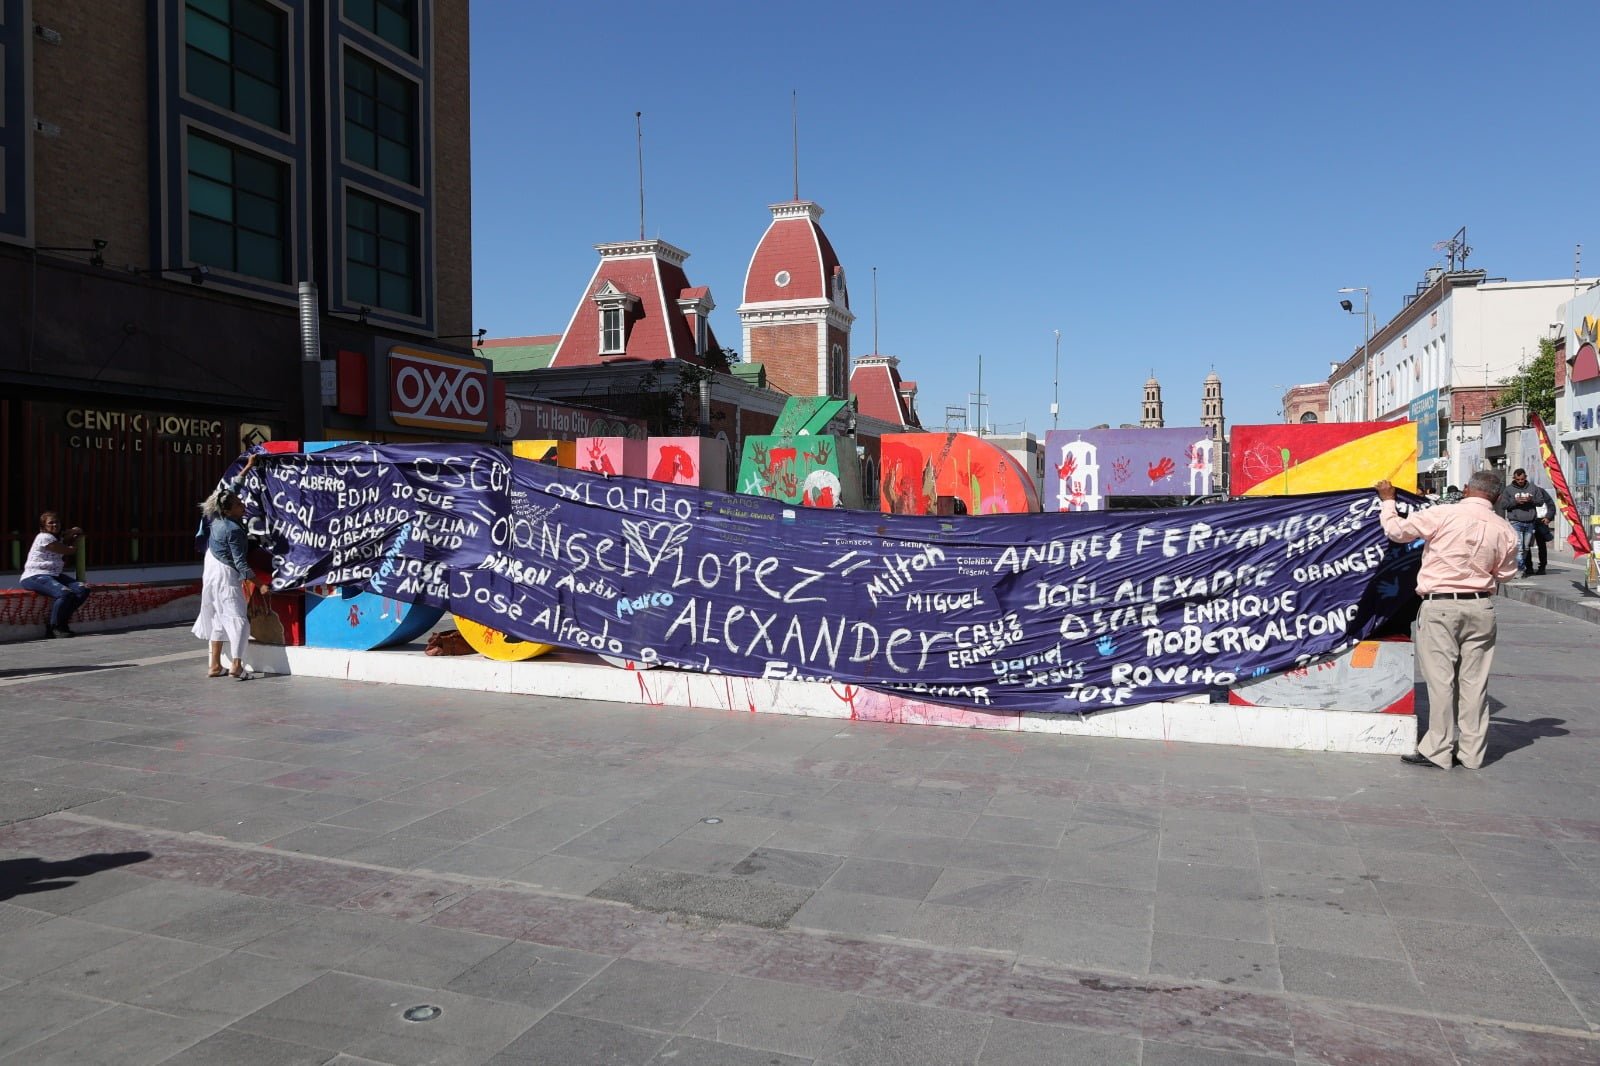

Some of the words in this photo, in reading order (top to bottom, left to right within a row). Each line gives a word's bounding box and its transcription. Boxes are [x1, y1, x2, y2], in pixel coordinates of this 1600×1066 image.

[397, 366, 485, 416] OXXO
[536, 405, 549, 429] Fu
[551, 408, 570, 431] Hao
[571, 411, 590, 436] City
[338, 487, 380, 510] EDIN
[392, 482, 455, 510] JOSUE
[413, 510, 479, 538] JULIAN
[412, 527, 463, 550] DAVID
[993, 532, 1123, 574] ANDRES
[326, 566, 373, 584] DIEGO
